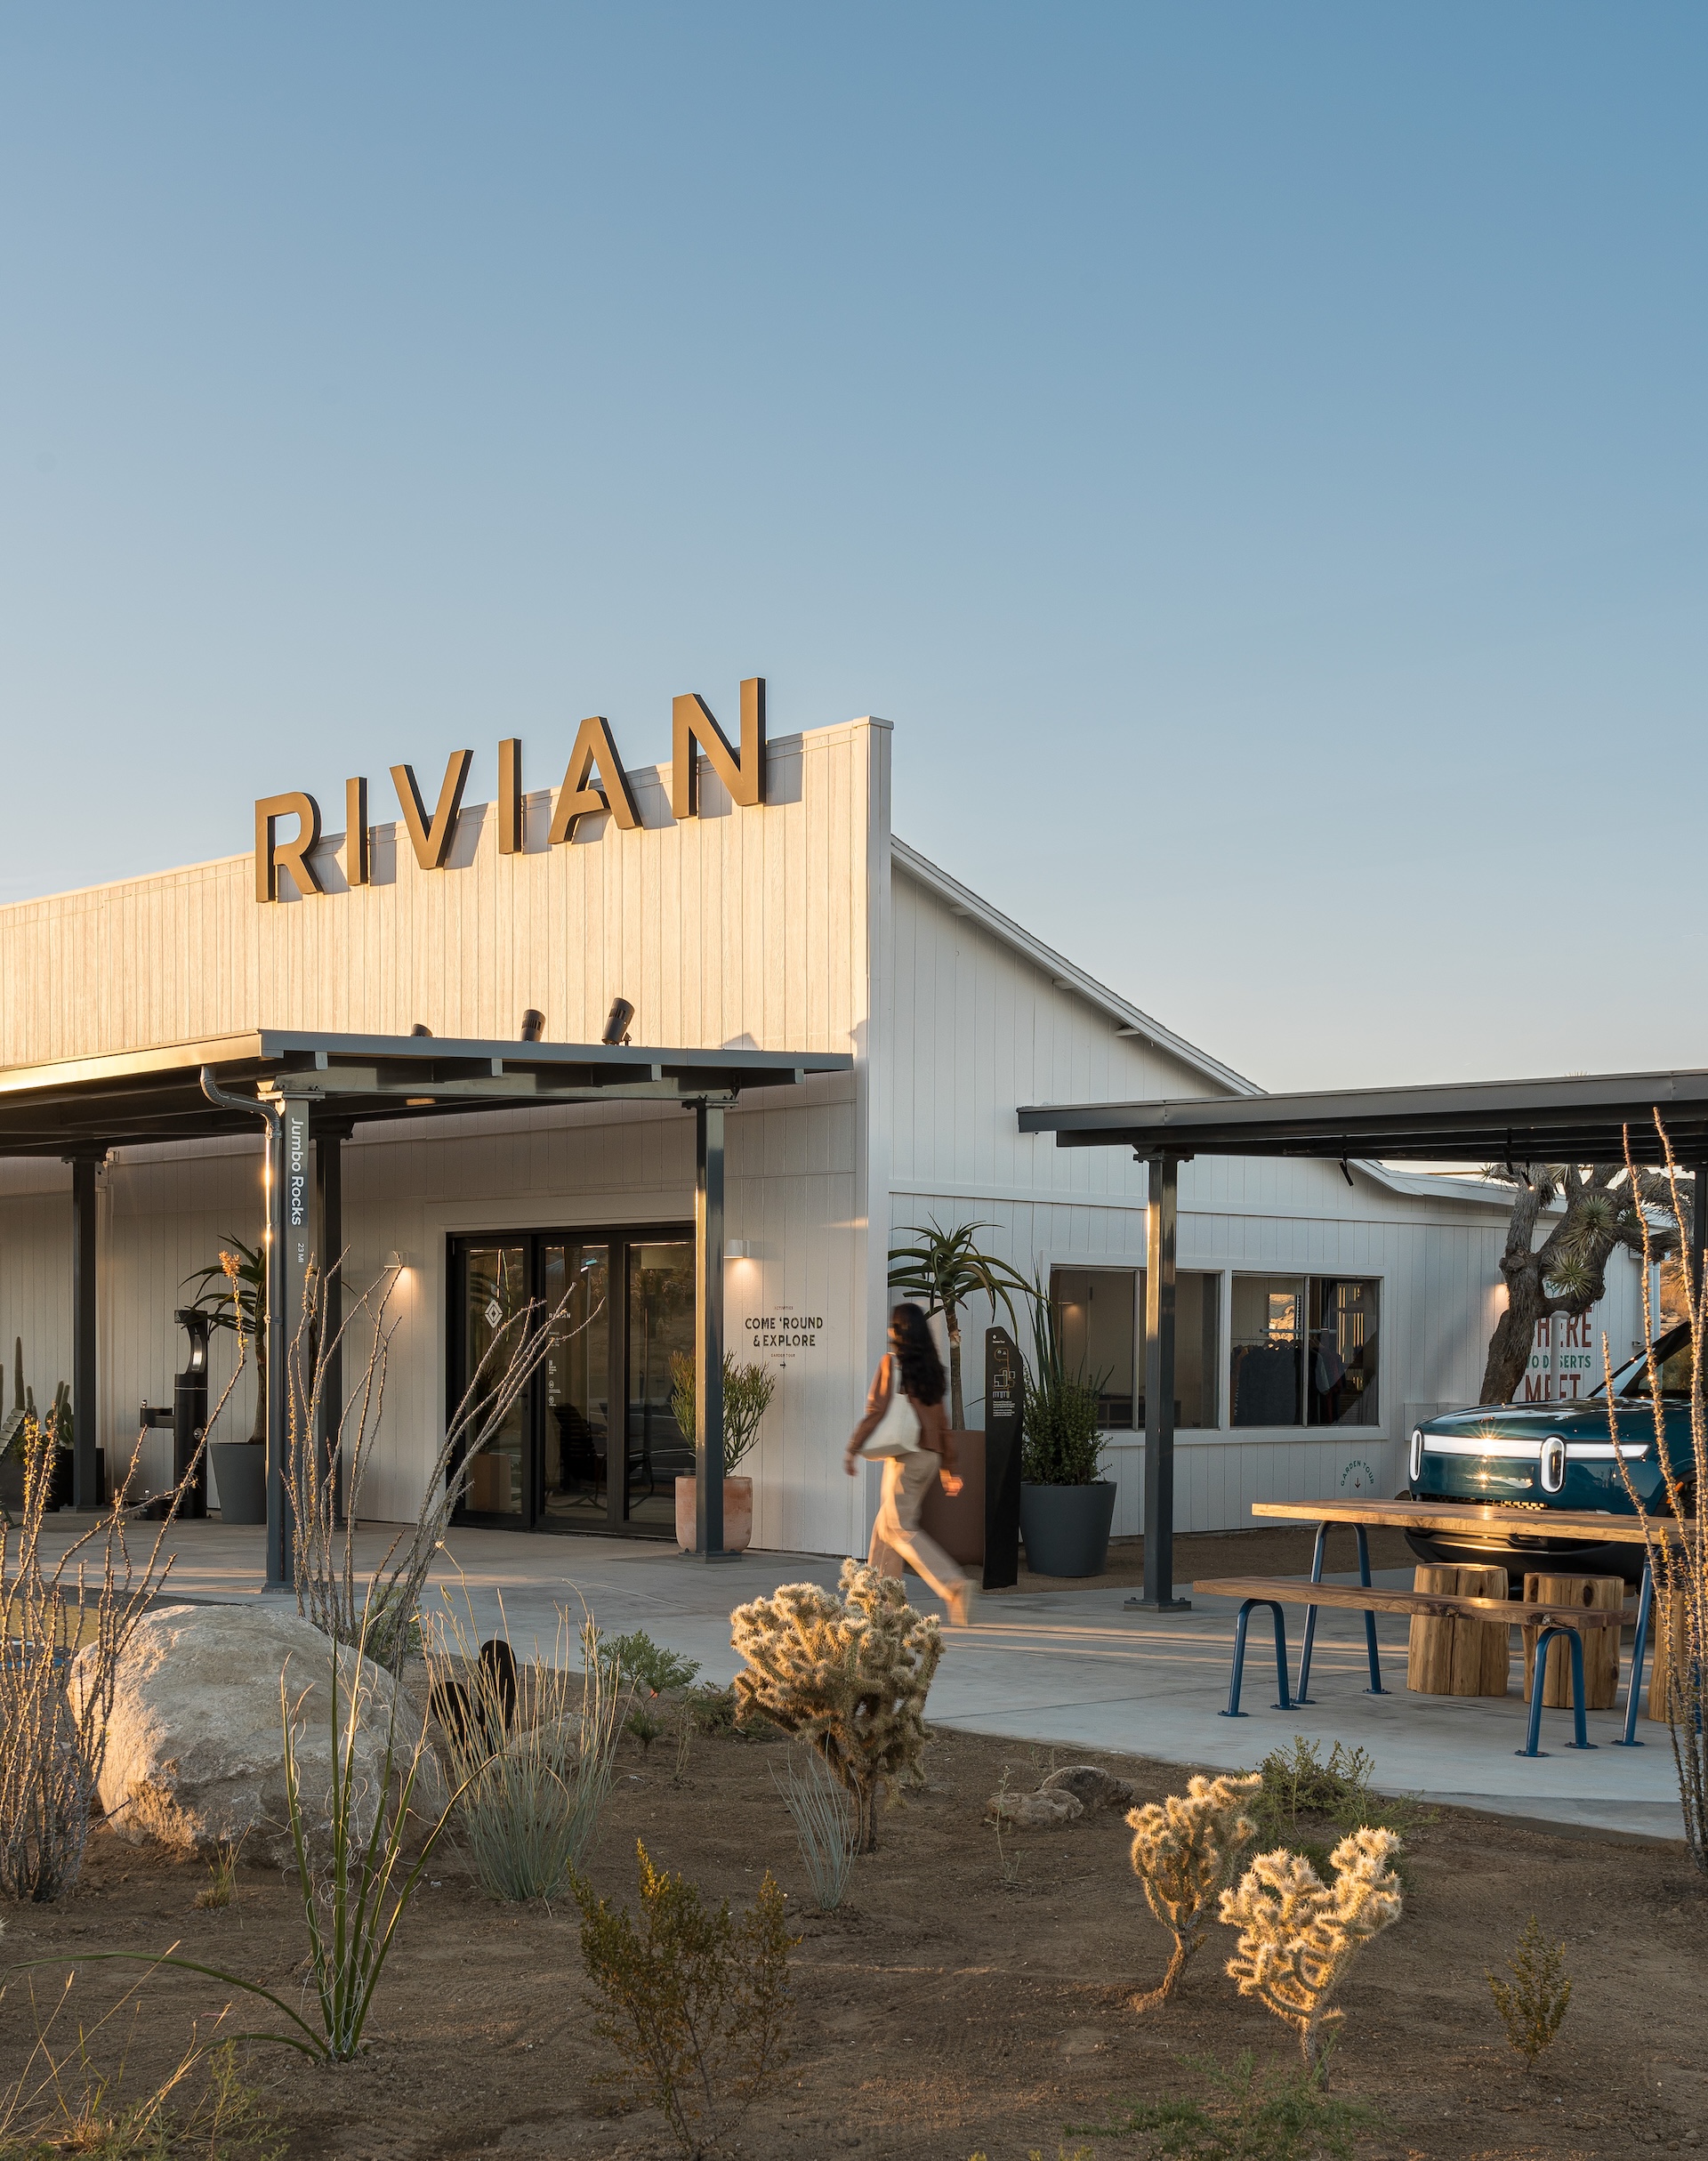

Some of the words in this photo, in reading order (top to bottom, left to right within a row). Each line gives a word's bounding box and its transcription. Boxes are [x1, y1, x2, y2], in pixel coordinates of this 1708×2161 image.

[255, 677, 766, 903] RIVIAN
[291, 1117, 304, 1173] Jumbo
[291, 1175, 304, 1226] Rocks
[297, 1242, 304, 1253] 23
[297, 1253, 304, 1263] MI
[745, 1318, 776, 1330] COME
[753, 1335, 761, 1347] &
[763, 1334, 816, 1347] EXPLORE
[1543, 1354, 1591, 1368] DSERTS
[1340, 1460, 1362, 1487] GARDEN
[1362, 1462, 1374, 1484] TOUR
